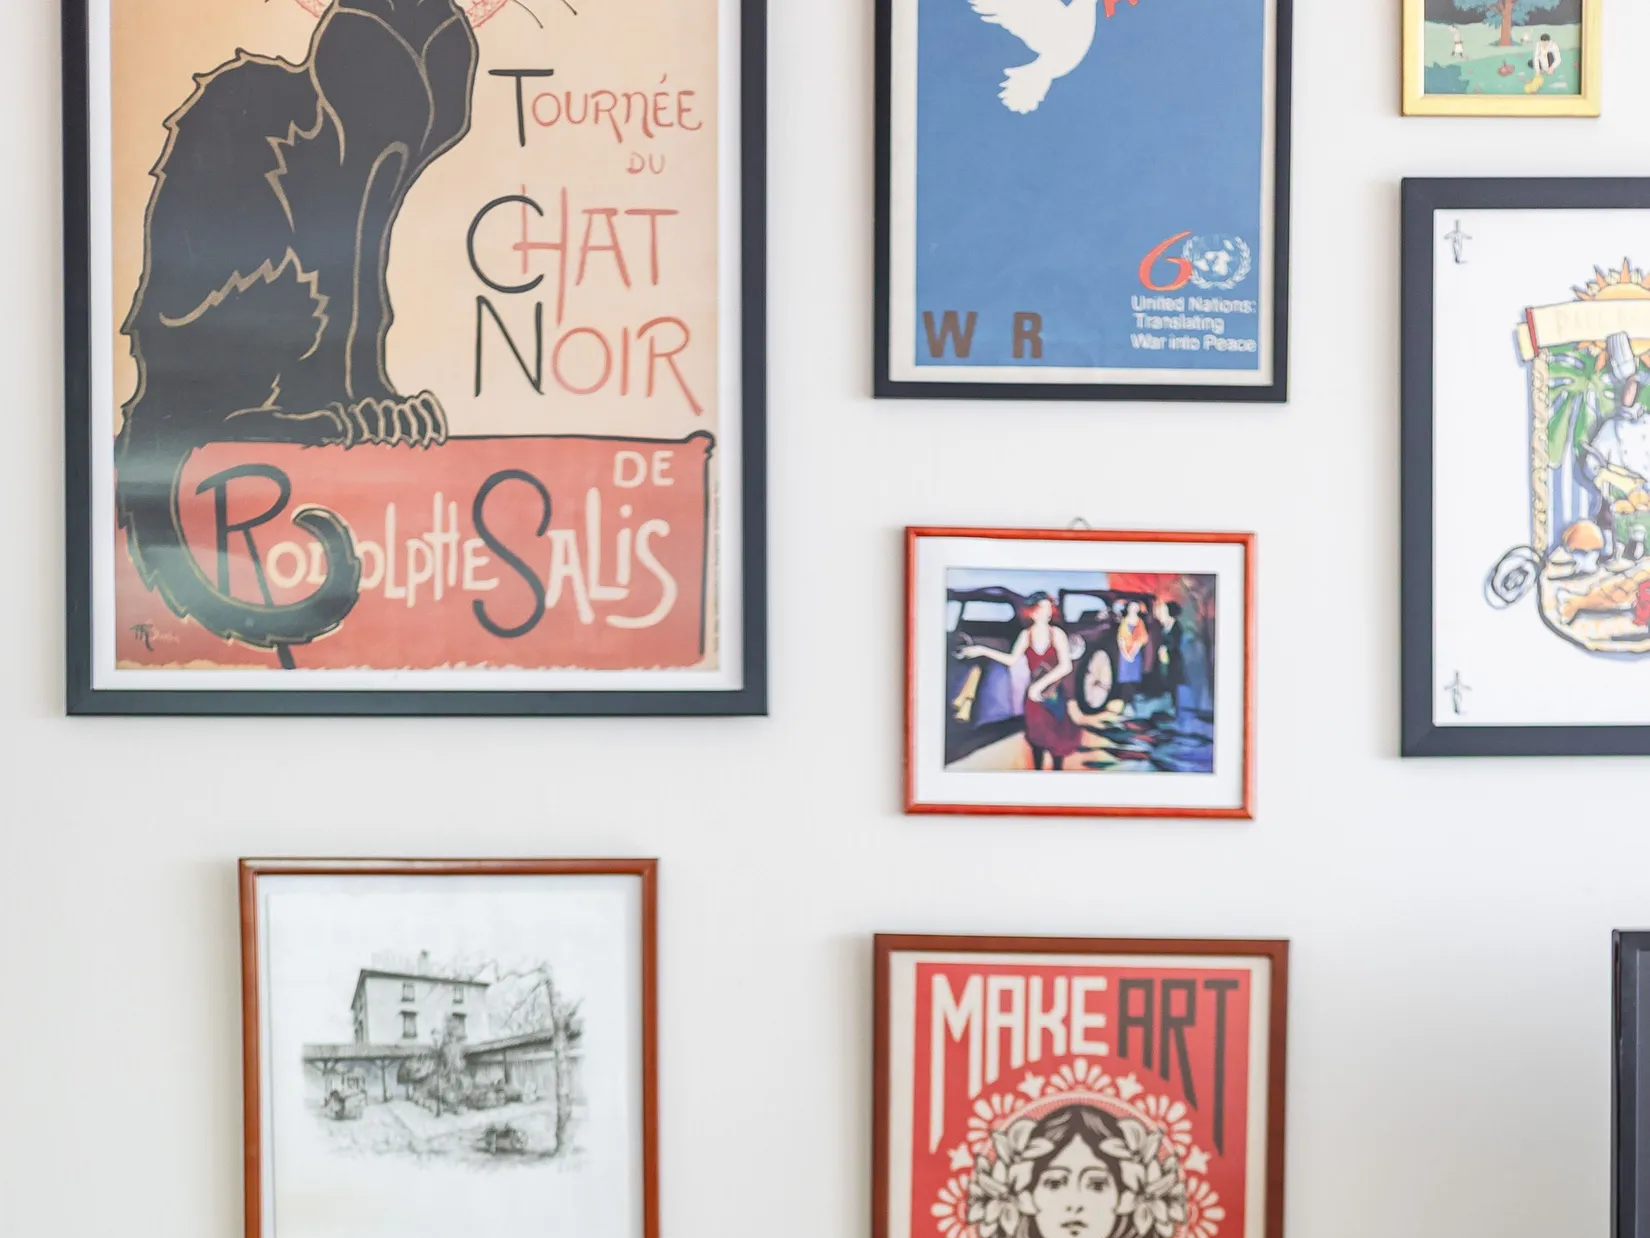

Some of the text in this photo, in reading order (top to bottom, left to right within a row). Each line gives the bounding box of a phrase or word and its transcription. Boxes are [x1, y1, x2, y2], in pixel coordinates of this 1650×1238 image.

[626, 151, 666, 174] DU
[466, 184, 679, 327] CHAT
[1130, 295, 1185, 312] United
[1132, 312, 1225, 335] Translating
[474, 295, 704, 417] NOIR
[1130, 333, 1257, 352] War into Peace
[613, 450, 675, 488] DE
[929, 973, 1240, 1158] MAKE ART
